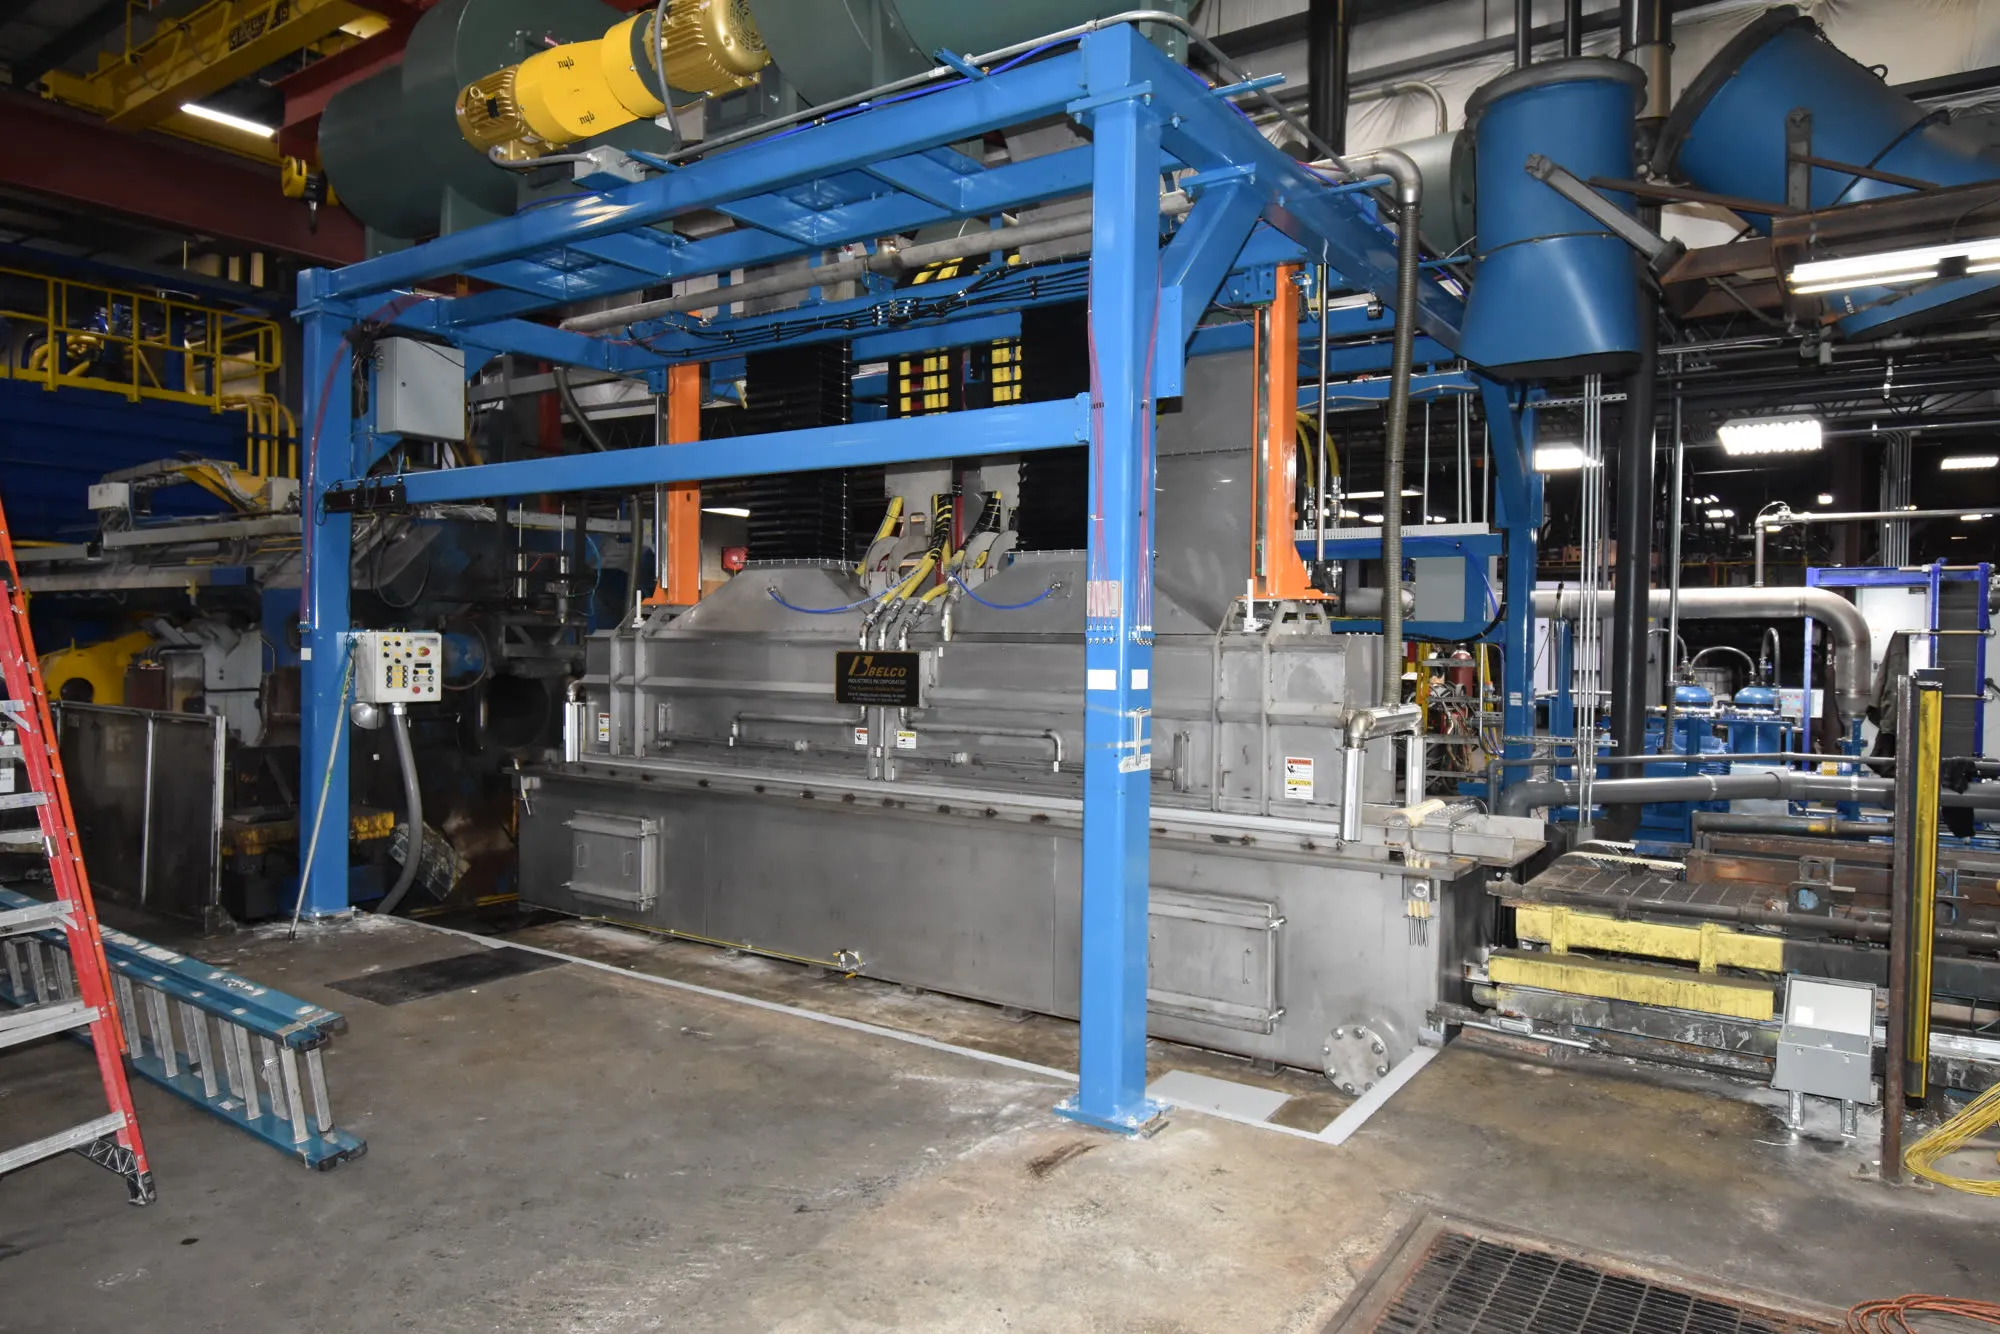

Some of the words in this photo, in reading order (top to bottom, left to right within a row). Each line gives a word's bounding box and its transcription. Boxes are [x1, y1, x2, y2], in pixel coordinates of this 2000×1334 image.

[557, 56, 575, 70] nyb
[579, 110, 595, 125] nyb
[868, 667, 906, 677] BELCO
